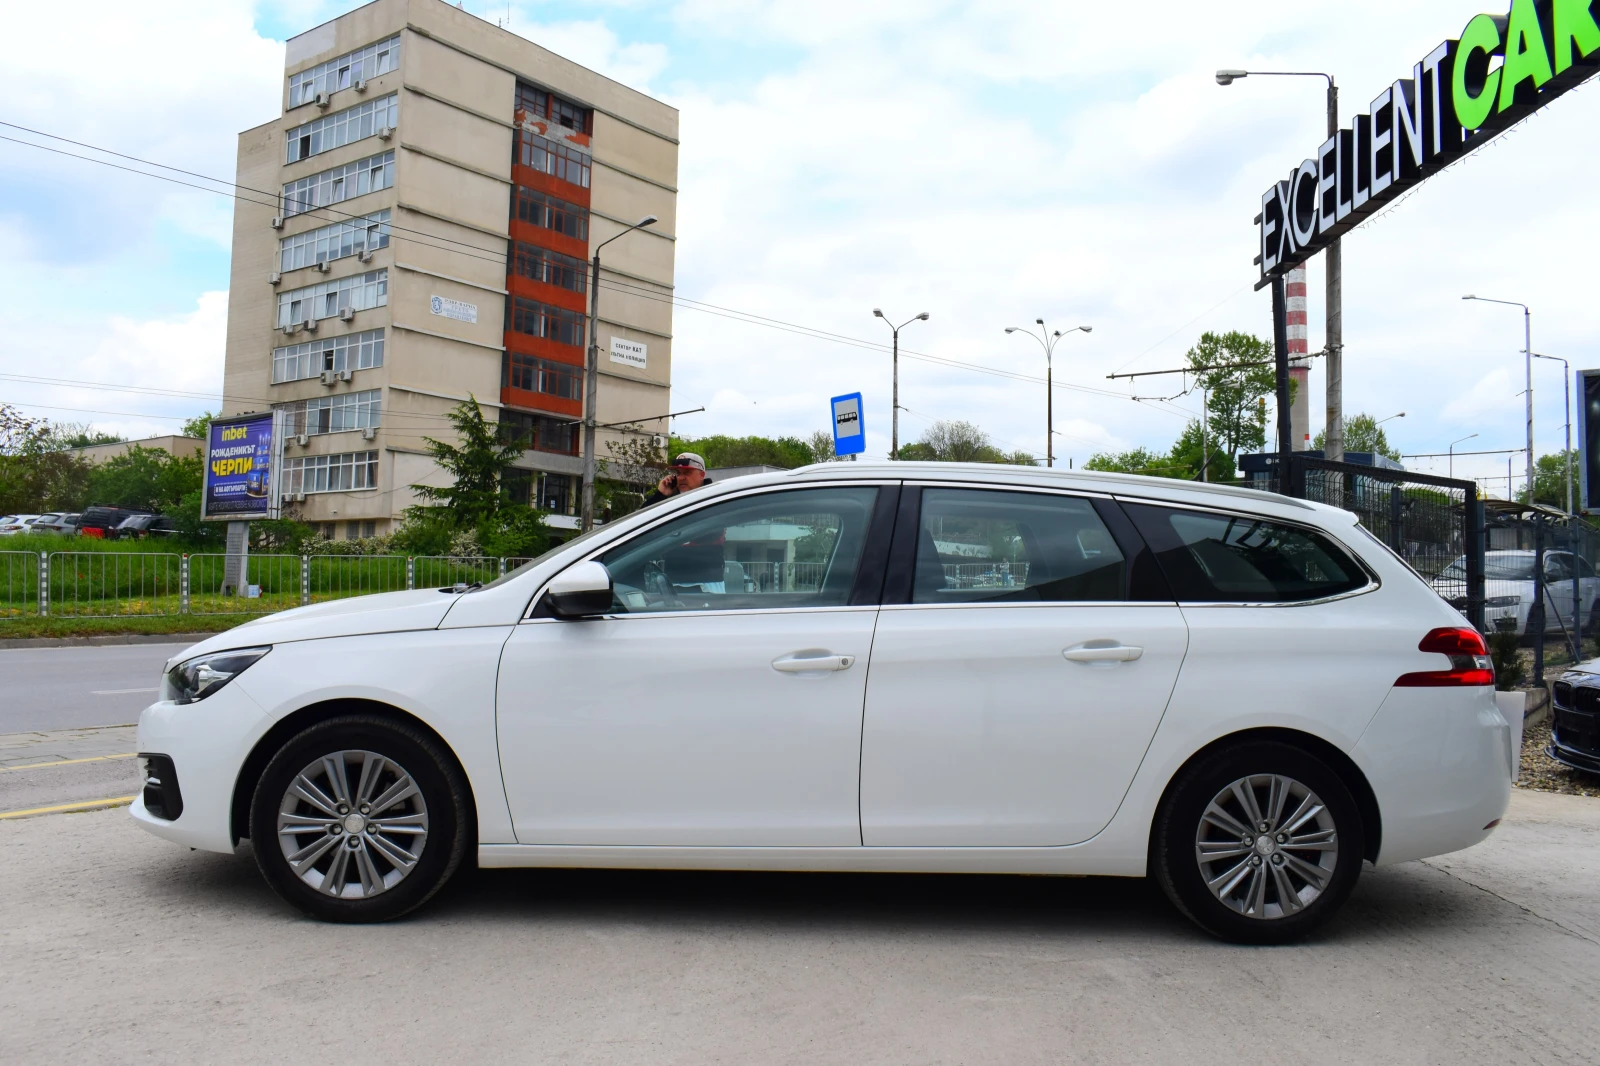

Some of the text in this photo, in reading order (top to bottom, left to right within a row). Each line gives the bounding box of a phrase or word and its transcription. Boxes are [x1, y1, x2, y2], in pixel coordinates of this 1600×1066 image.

[1262, 40, 1448, 274] EXCELLENT
[222, 426, 247, 441] inbet
[211, 445, 255, 458] РОЖДЕНИКЪТ
[212, 457, 253, 476] ЧЕРПИ
